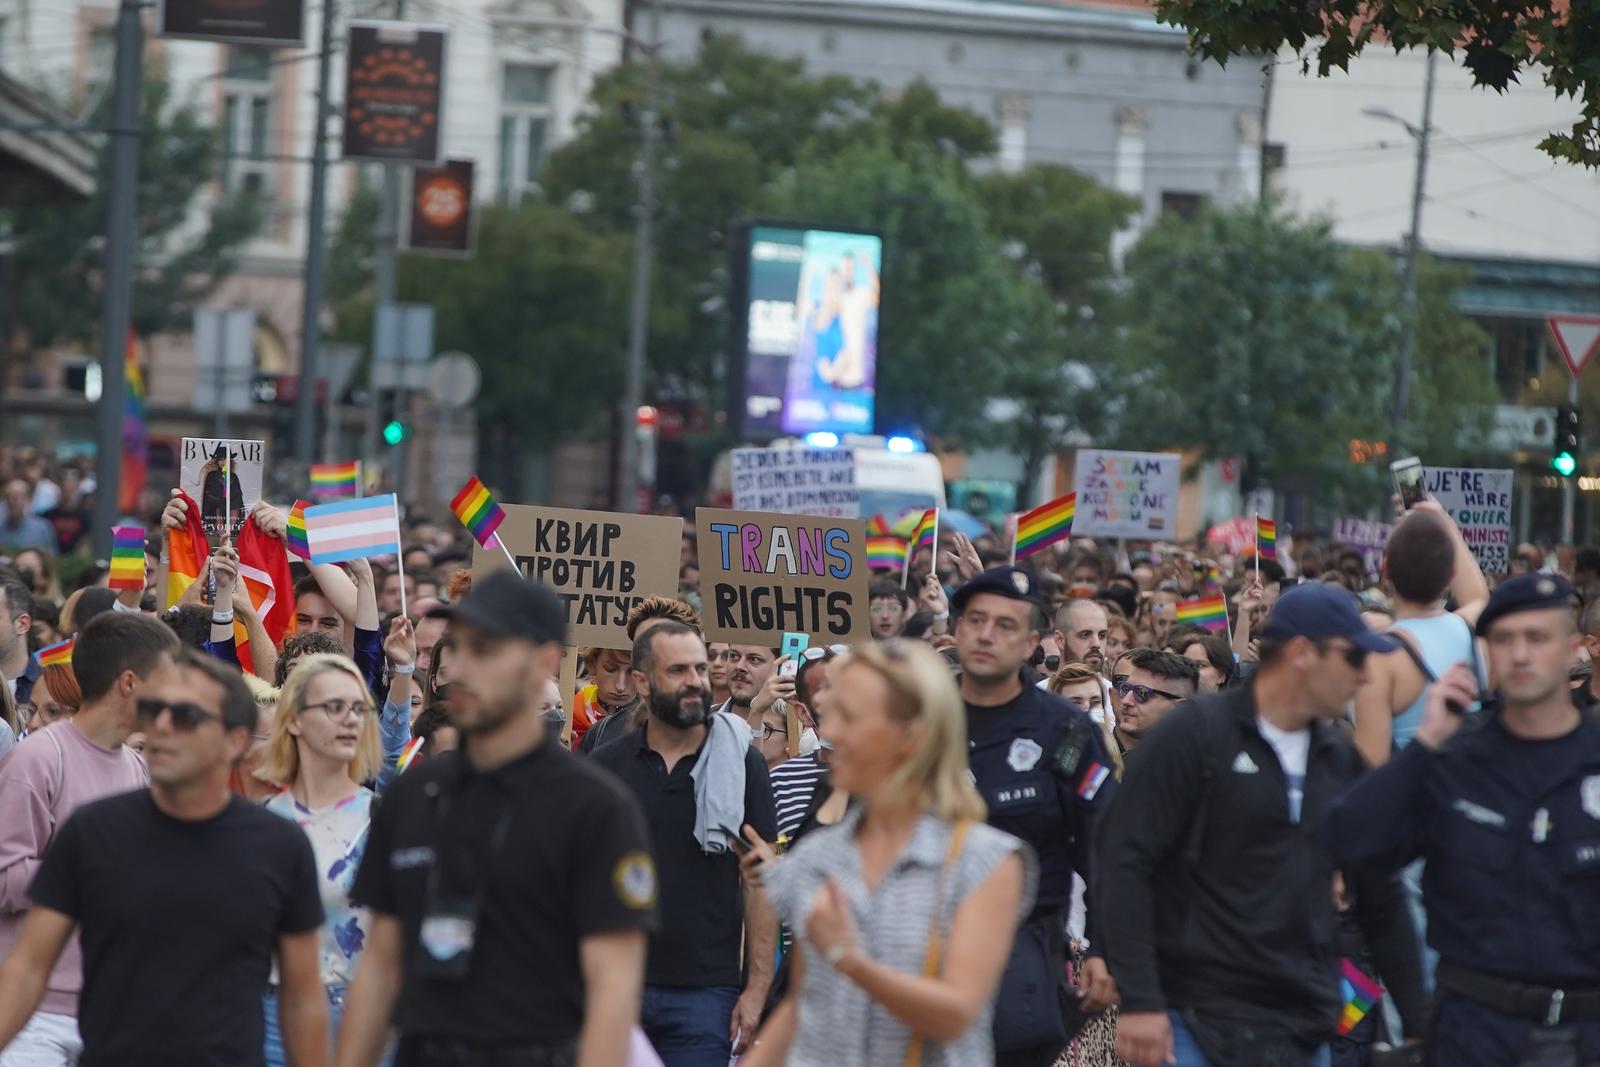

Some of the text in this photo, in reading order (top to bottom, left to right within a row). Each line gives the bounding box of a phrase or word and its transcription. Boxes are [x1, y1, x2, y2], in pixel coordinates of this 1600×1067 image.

[535, 518, 621, 557] КВИР
[710, 523, 852, 579] TRANS
[1459, 527, 1509, 545] MINISTS
[515, 556, 636, 592] ПРОТИВ
[715, 583, 852, 635] RIGHTS
